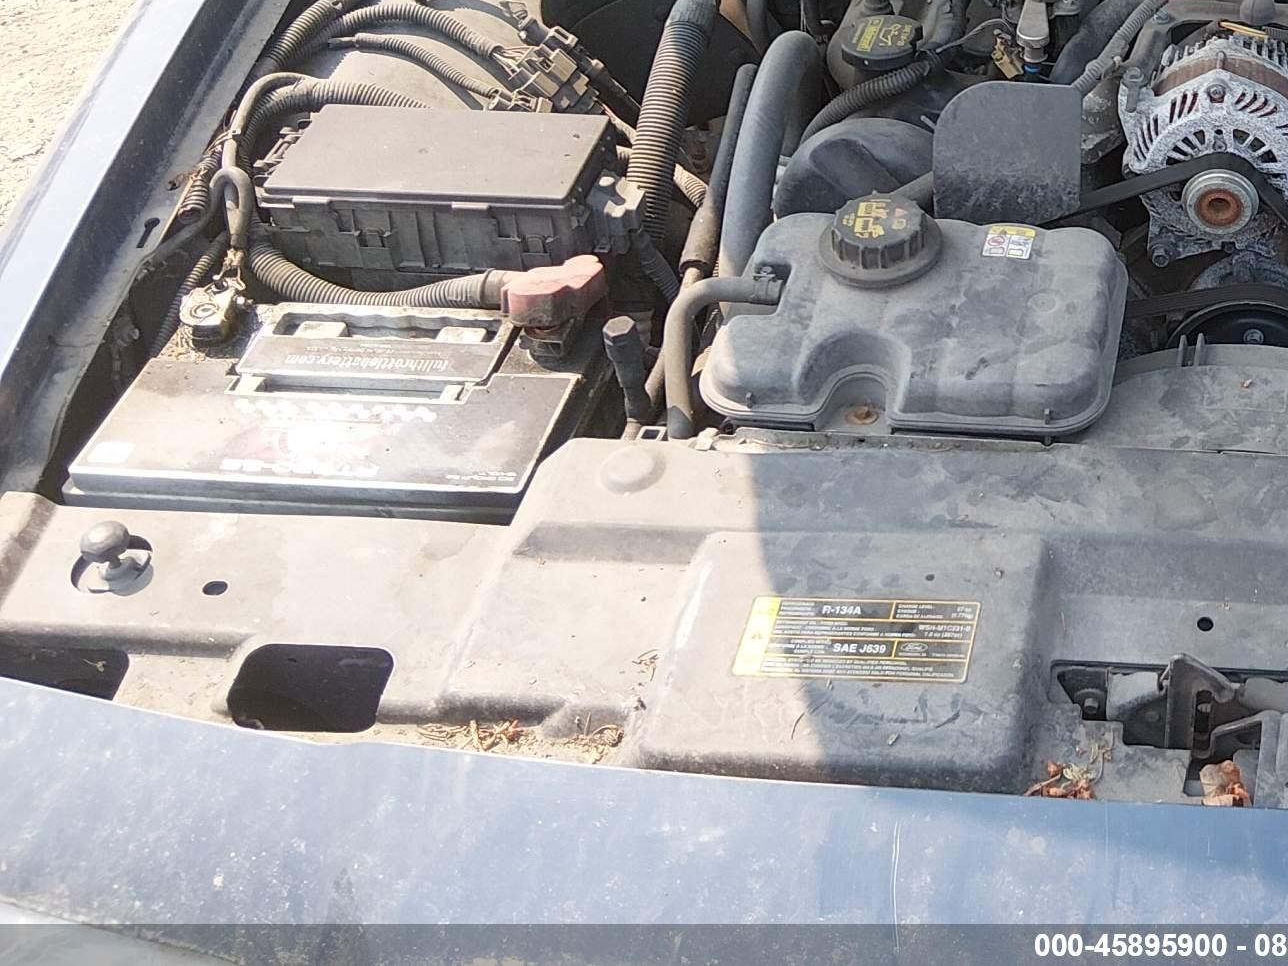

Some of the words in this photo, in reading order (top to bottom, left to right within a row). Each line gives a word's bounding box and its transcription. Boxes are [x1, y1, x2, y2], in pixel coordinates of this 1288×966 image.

[821, 605, 862, 615] R-134A
[833, 643, 858, 653] SAE
[859, 644, 886, 654] J639
